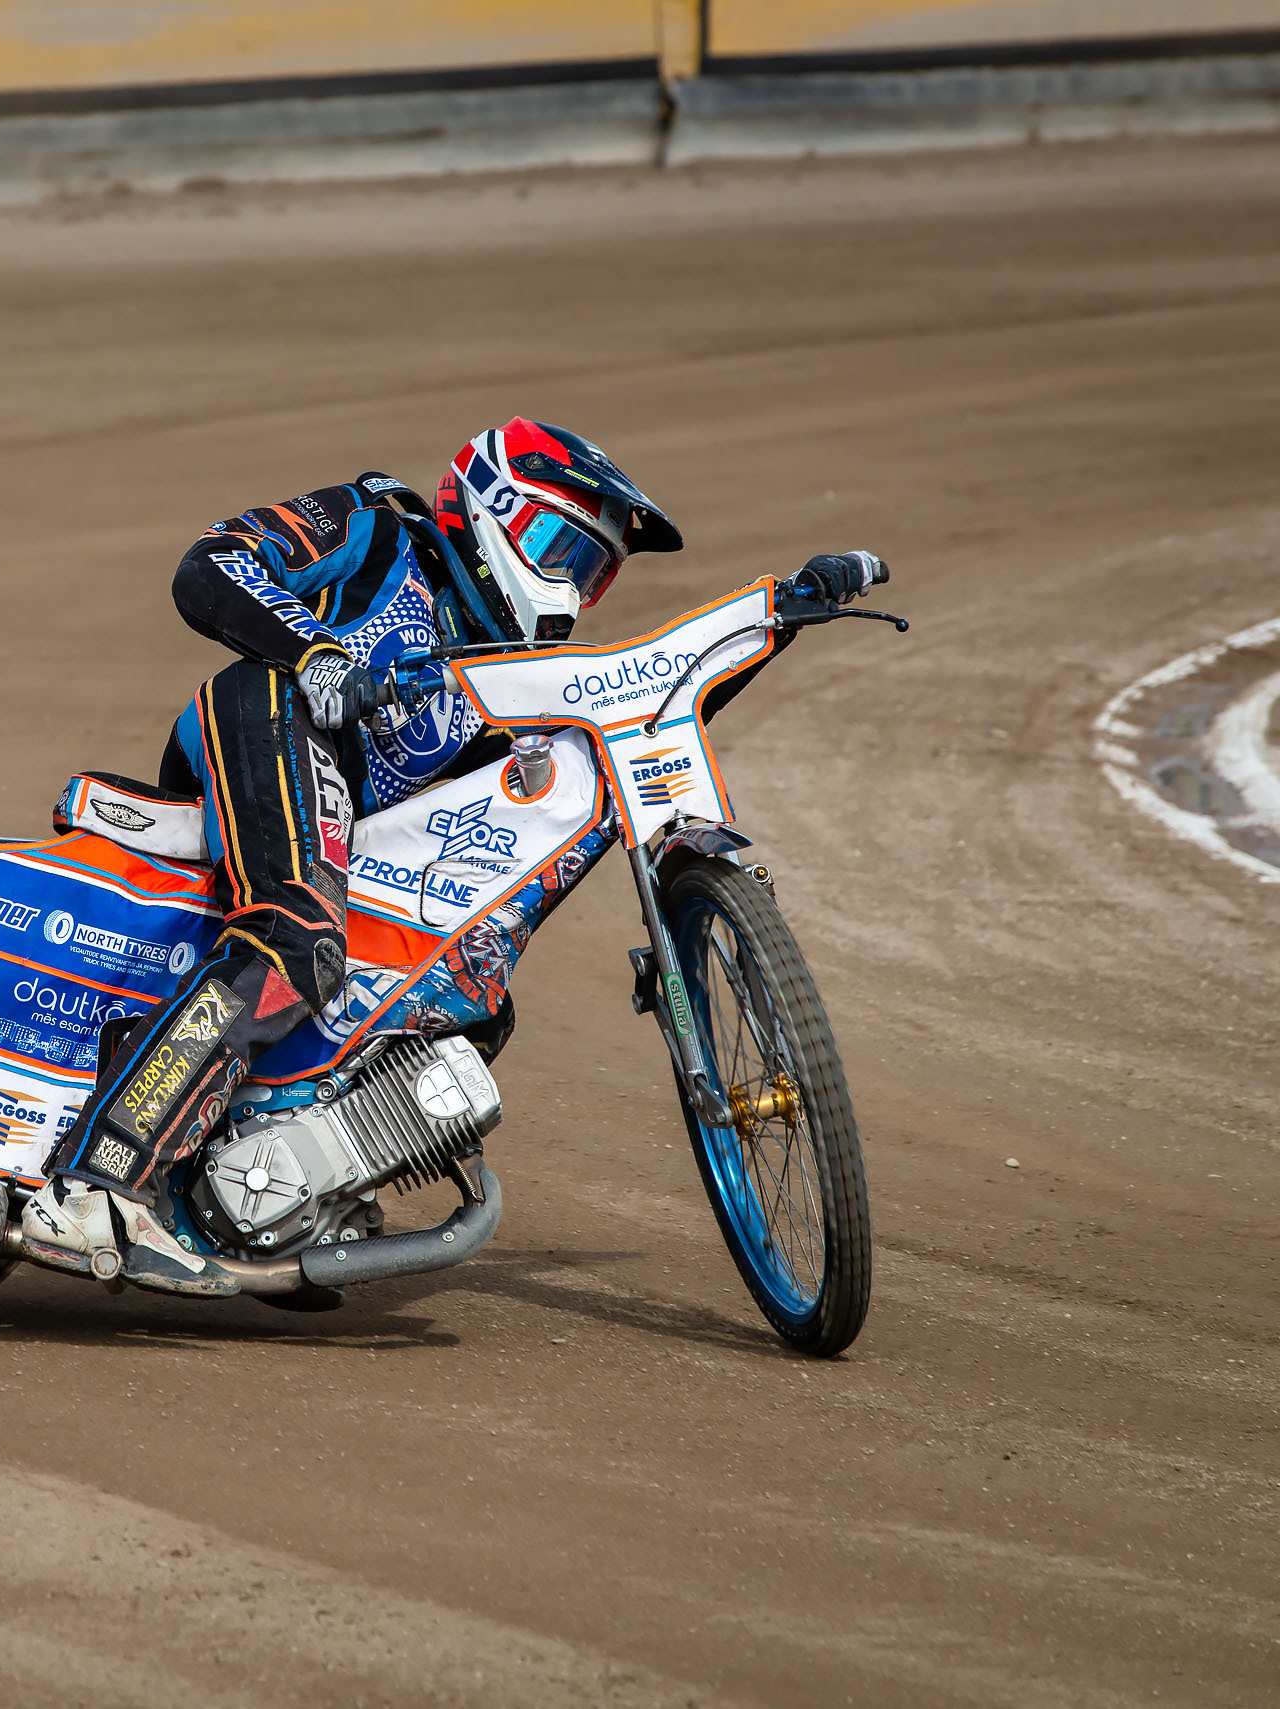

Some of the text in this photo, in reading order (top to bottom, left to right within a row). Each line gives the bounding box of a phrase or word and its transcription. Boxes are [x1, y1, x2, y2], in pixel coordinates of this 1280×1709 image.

[618, 690, 650, 706] esam
[631, 757, 692, 782] ERGOSS
[76, 927, 168, 961] NORTH TYRES
[82, 956, 100, 967] TRUCK
[100, 961, 116, 971] TYRES
[59, 1019, 92, 1036] esam
[124, 1045, 173, 1113] CARPETS
[135, 1055, 191, 1134] KIRKLAND
[101, 1137, 137, 1162] MALI
[29, 1199, 67, 1238] TCX
